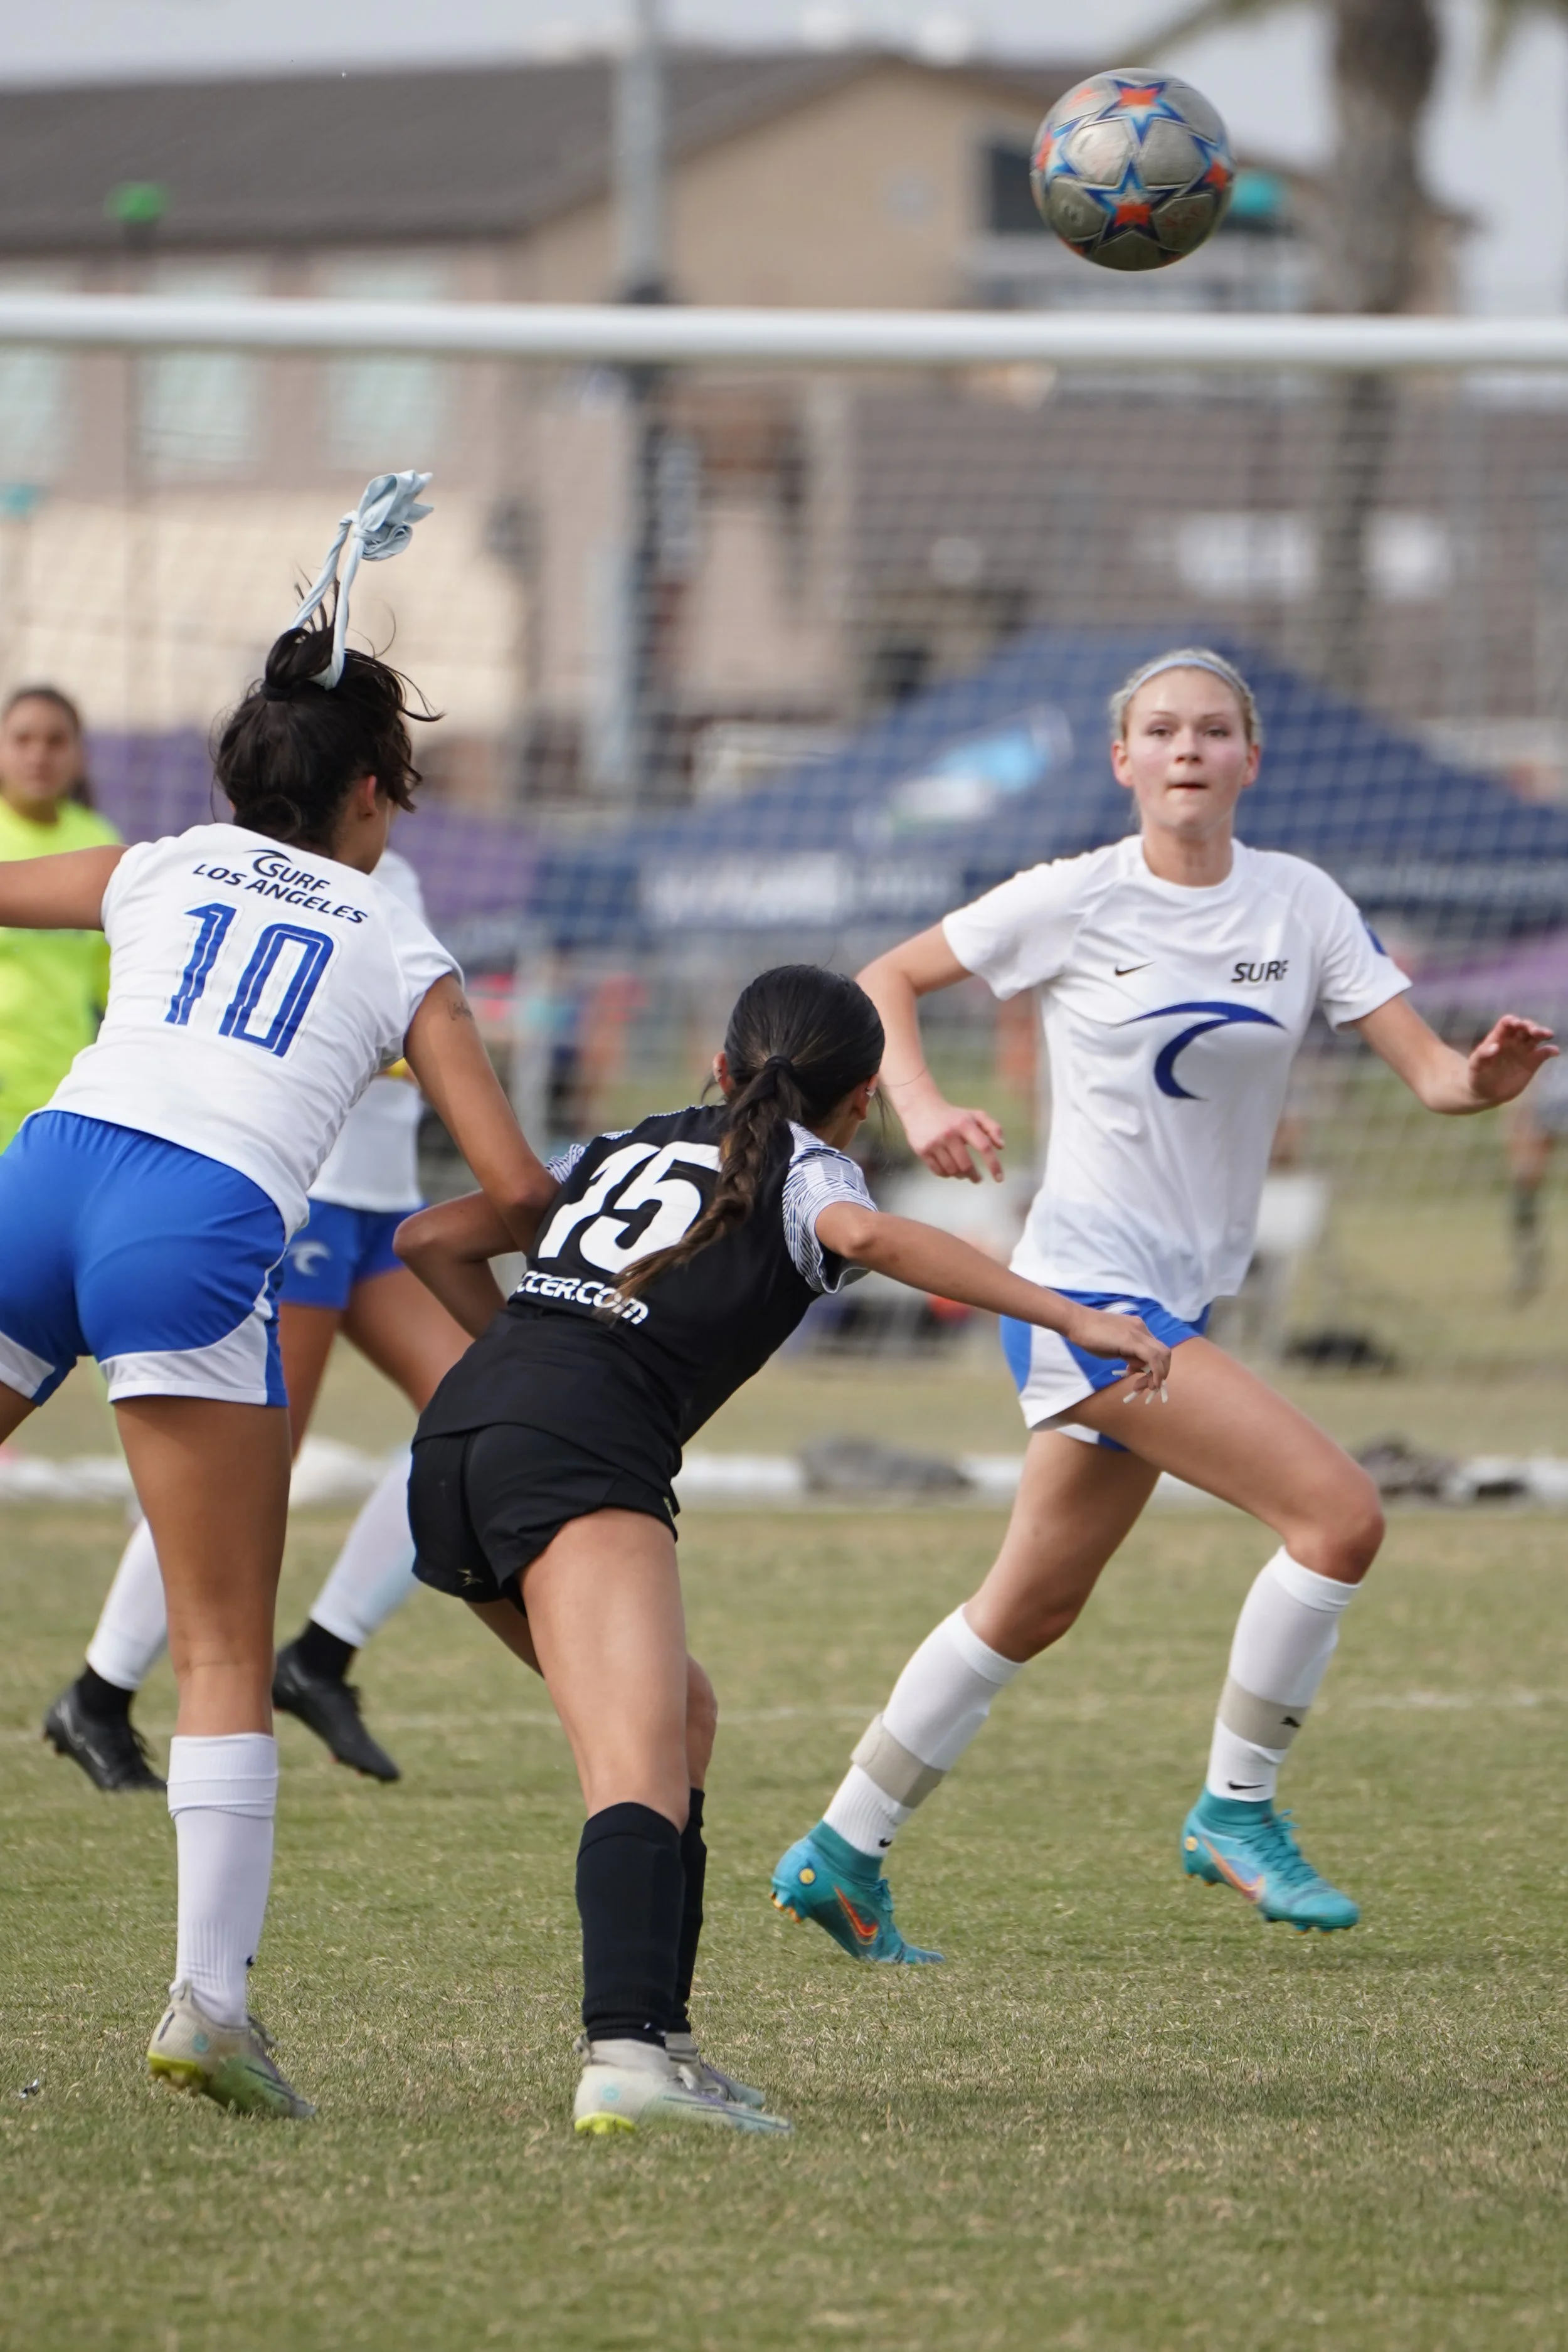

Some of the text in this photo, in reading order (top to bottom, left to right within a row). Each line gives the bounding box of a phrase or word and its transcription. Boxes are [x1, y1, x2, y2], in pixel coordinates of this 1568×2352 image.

[192, 864, 368, 924] LOS ANGELES
[265, 862, 331, 891] SURF
[164, 903, 334, 1058] 10
[1231, 960, 1289, 983] SURF
[538, 1141, 723, 1276] 15
